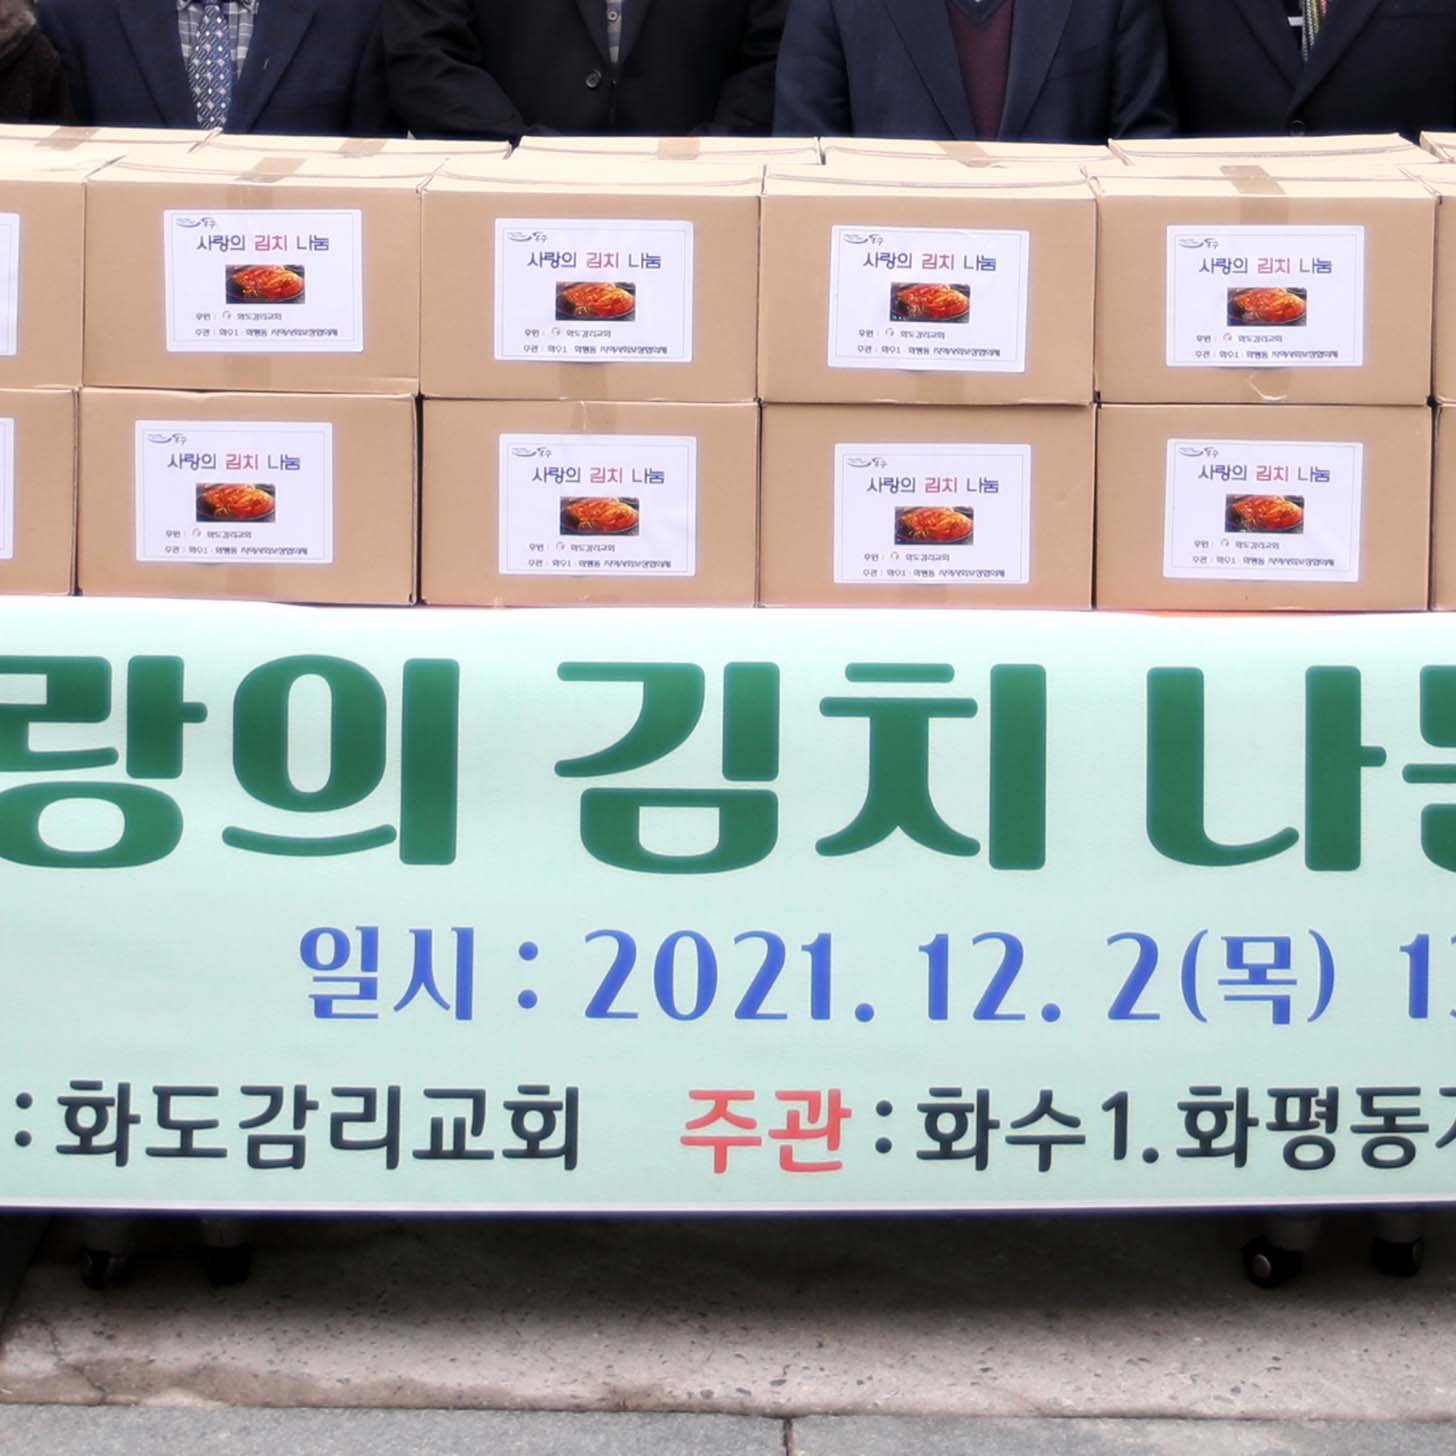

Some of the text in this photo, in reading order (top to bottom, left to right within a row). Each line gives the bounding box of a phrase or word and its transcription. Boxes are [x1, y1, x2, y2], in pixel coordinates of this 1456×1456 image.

[195, 234, 330, 253] 사랑의 김치 나눔
[527, 251, 662, 270] 사랑의 김치 나눔
[862, 251, 997, 272] 사랑의 김치 나눔
[1198, 257, 1333, 276] 사랑의 김치 나눔
[167, 452, 301, 472] 사랑의 김치 나눔
[531, 466, 665, 485] 사랑의 김치 나눔
[1197, 463, 1331, 483] 사랑의 김치 나눔
[866, 476, 1000, 495] 사랑의 김치 나눔
[554, 662, 1047, 875] 김치
